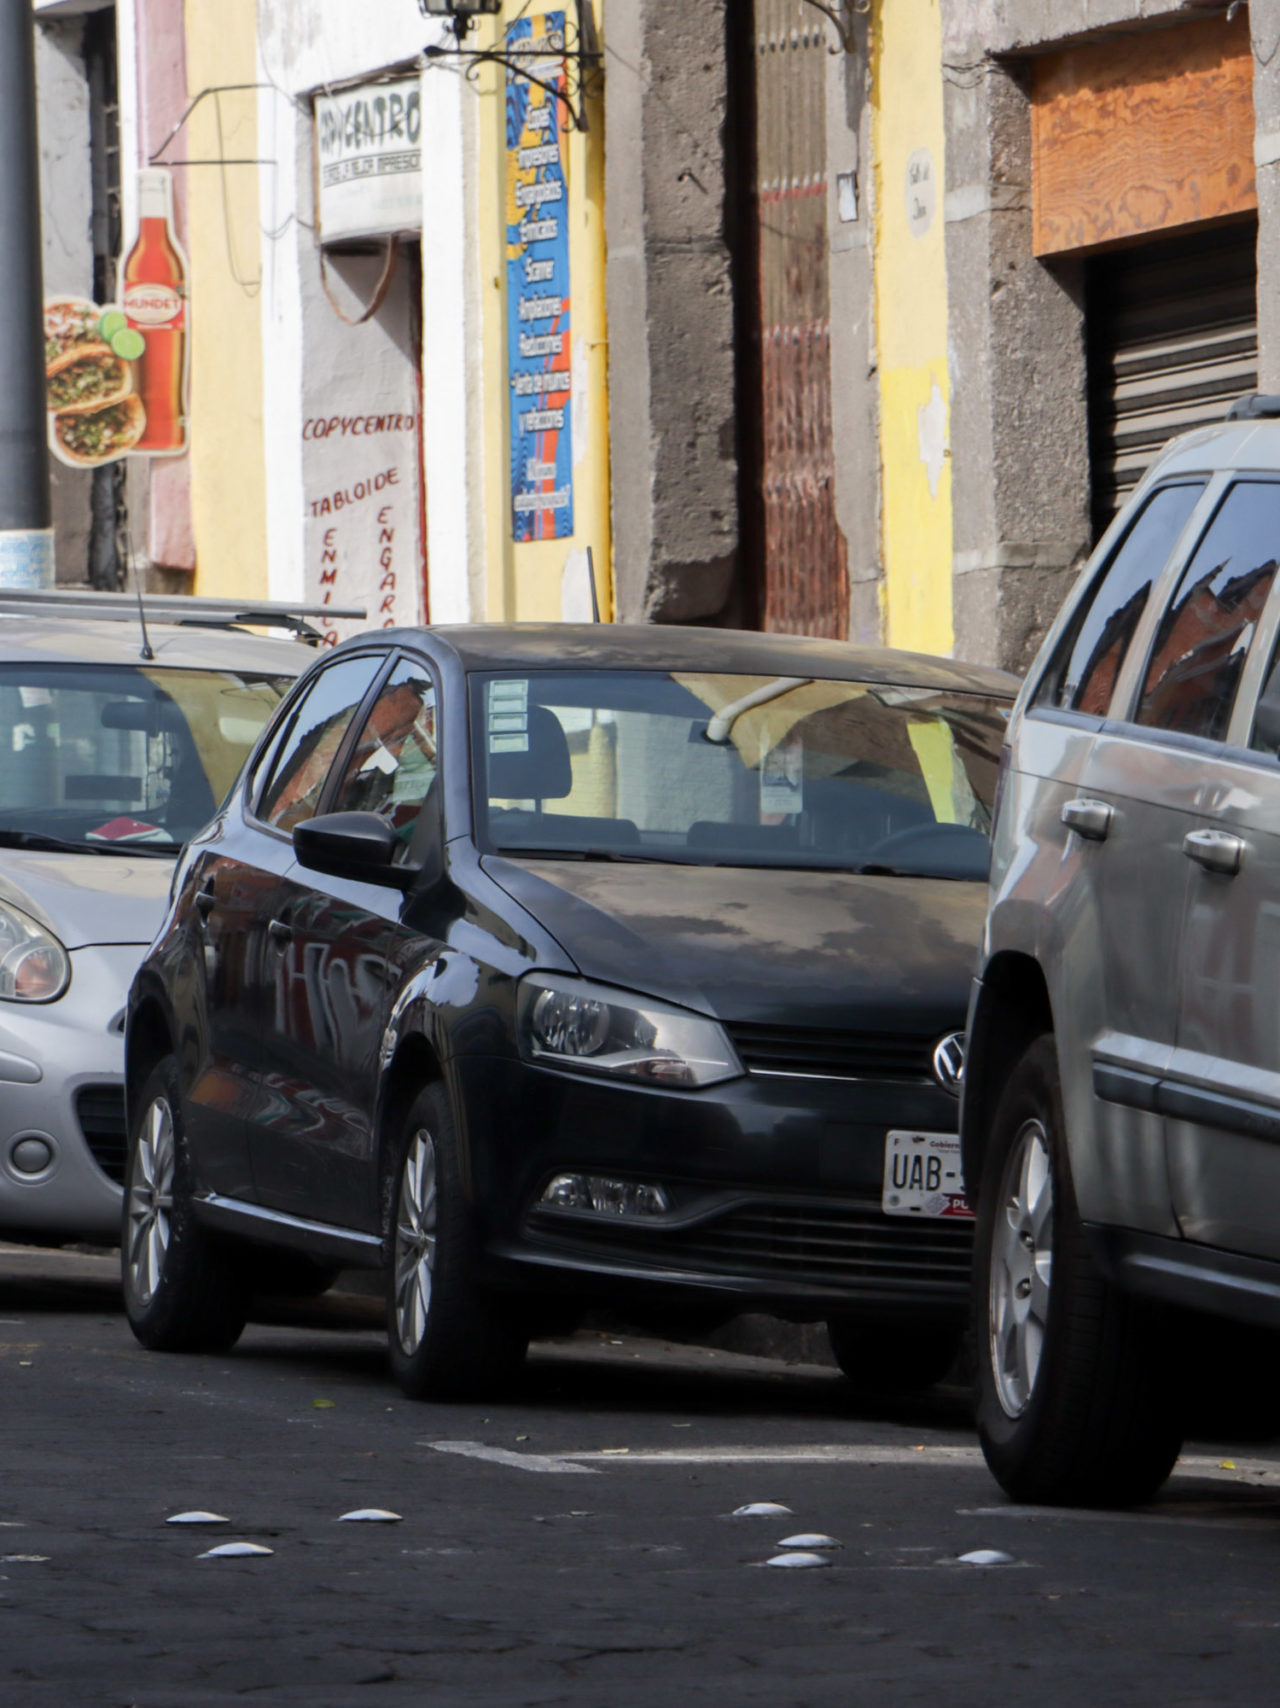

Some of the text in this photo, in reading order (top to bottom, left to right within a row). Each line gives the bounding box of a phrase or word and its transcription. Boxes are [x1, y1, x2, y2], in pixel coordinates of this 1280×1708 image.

[123, 297, 181, 311] MUNDET
[302, 413, 415, 441] COPYCENTRO
[310, 466, 400, 518] TABLOIDE
[892, 1153, 966, 1192] UAB-
